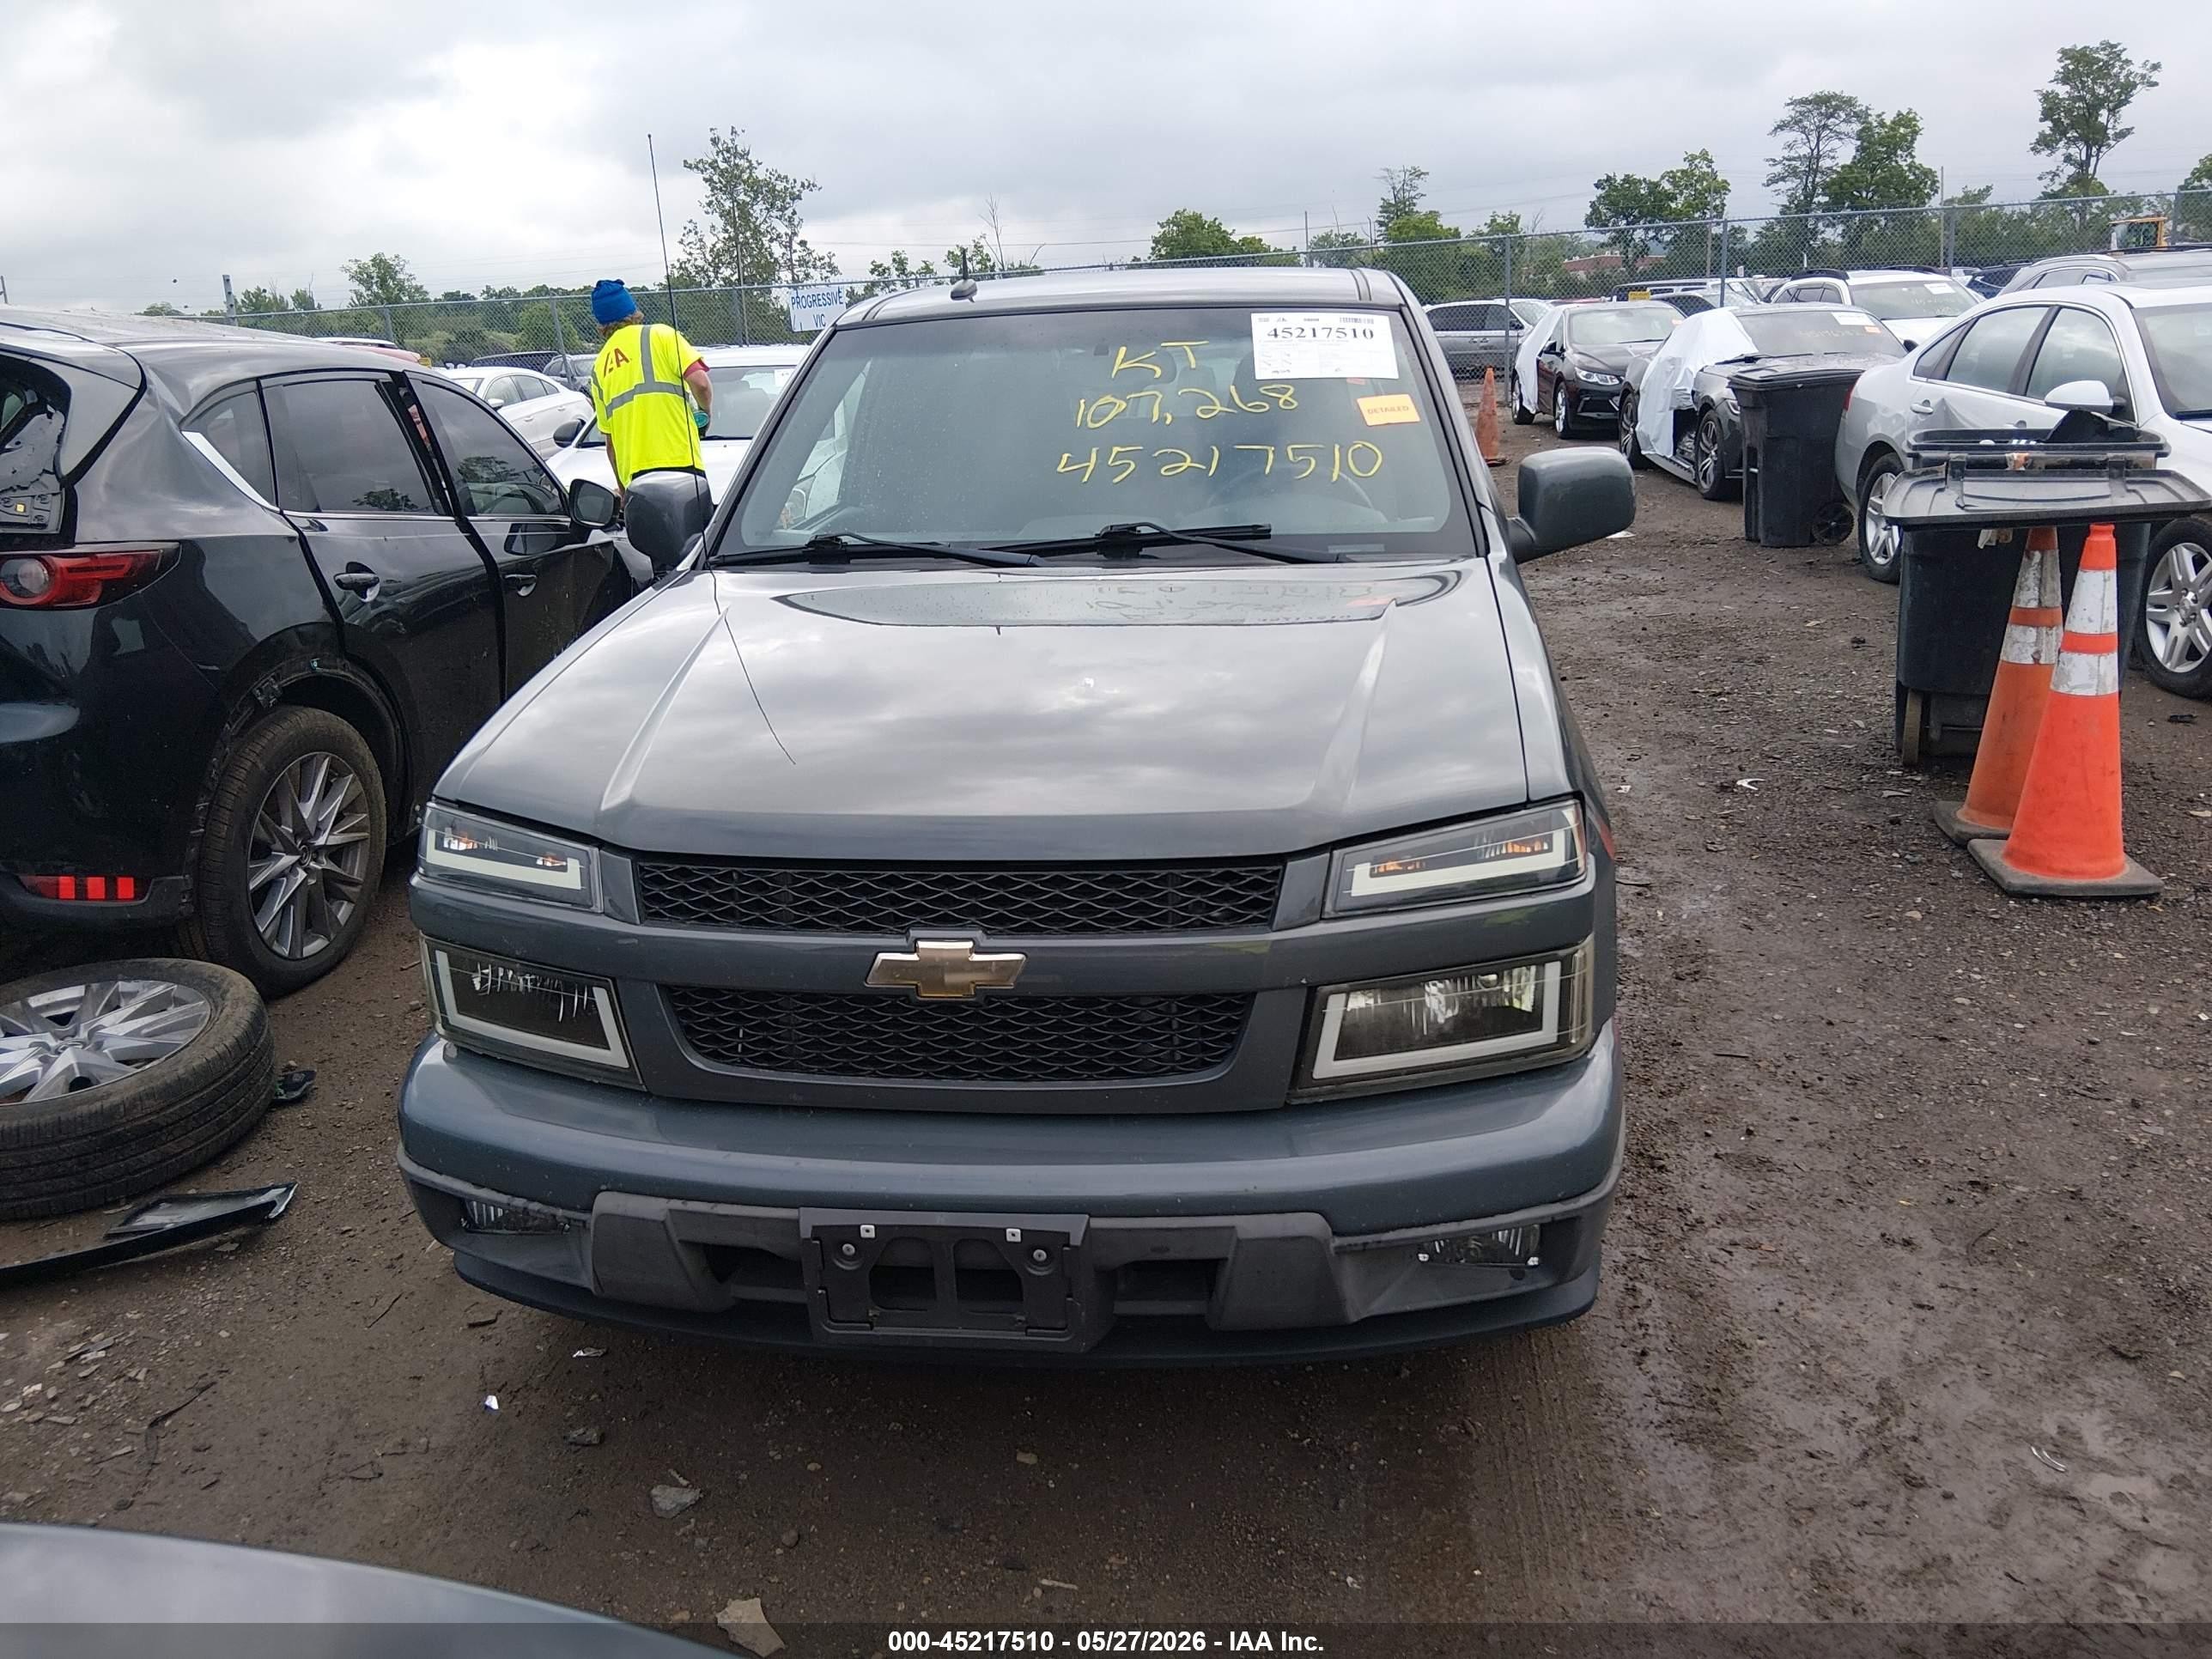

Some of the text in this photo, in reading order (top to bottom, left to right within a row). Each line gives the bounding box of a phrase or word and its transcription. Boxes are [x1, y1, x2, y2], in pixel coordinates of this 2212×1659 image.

[791, 291, 844, 310] PROGRESSIVE
[1267, 327, 1375, 340] 45217510
[1076, 384, 1299, 428] 107,268
[1056, 441, 1383, 483] 45217510
